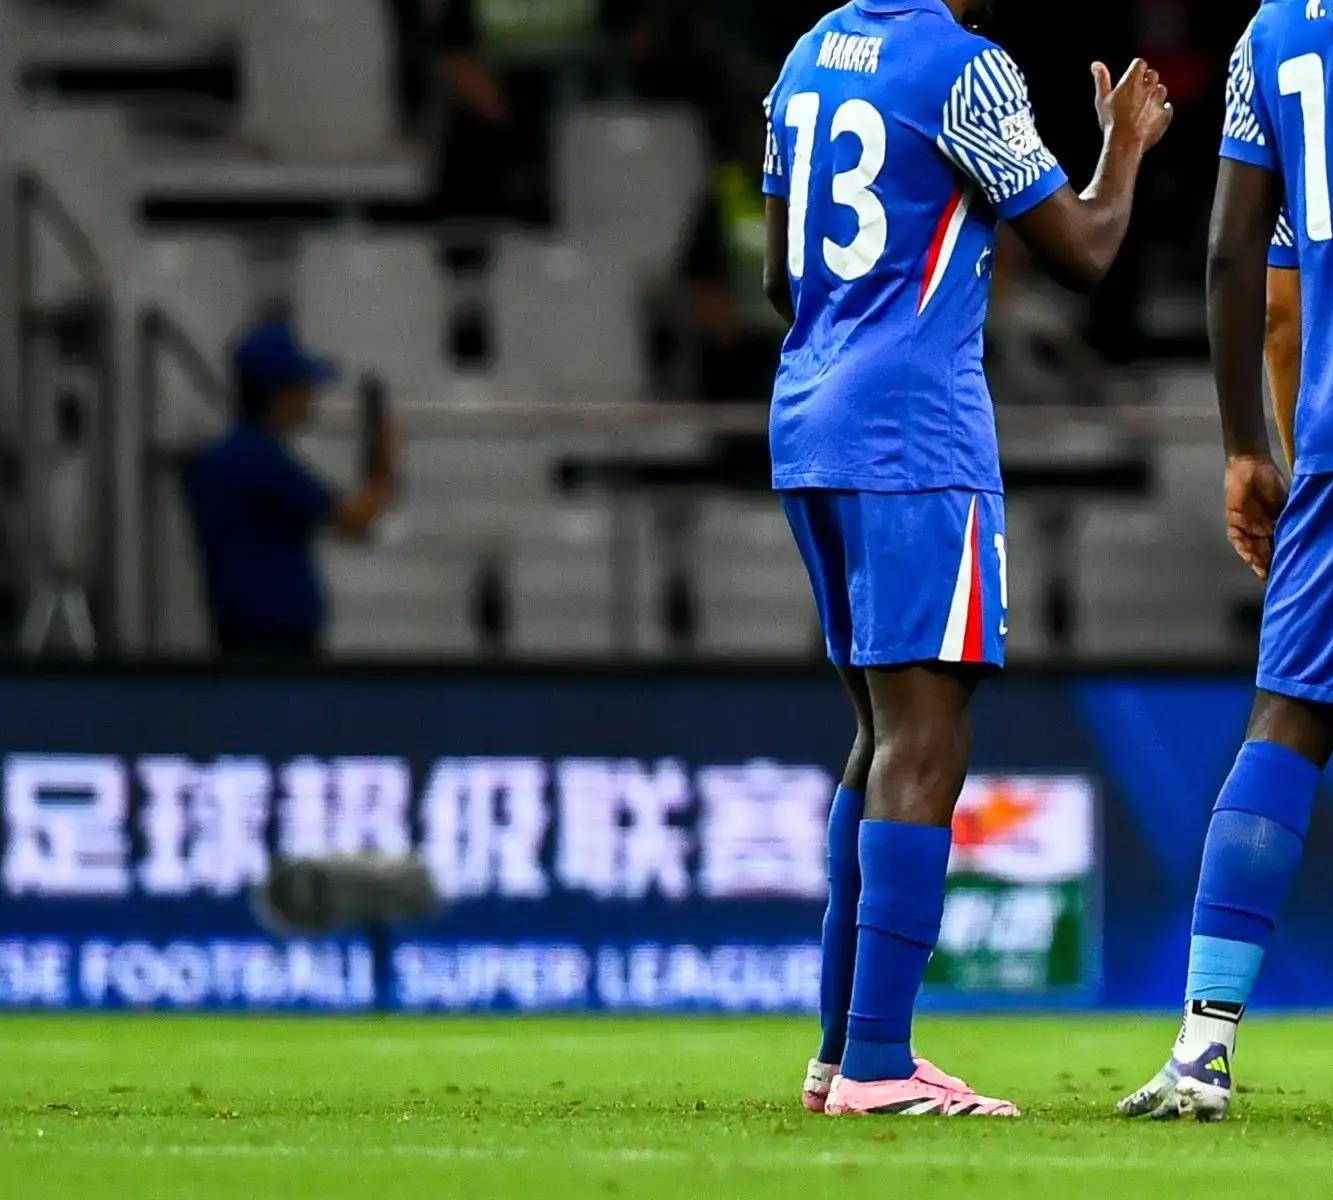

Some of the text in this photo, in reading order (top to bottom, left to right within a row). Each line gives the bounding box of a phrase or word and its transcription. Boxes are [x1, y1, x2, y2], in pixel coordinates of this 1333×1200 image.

[784, 91, 888, 281] 13
[79, 941, 376, 1007] FOOTBALL
[394, 943, 593, 1009] SUPER
